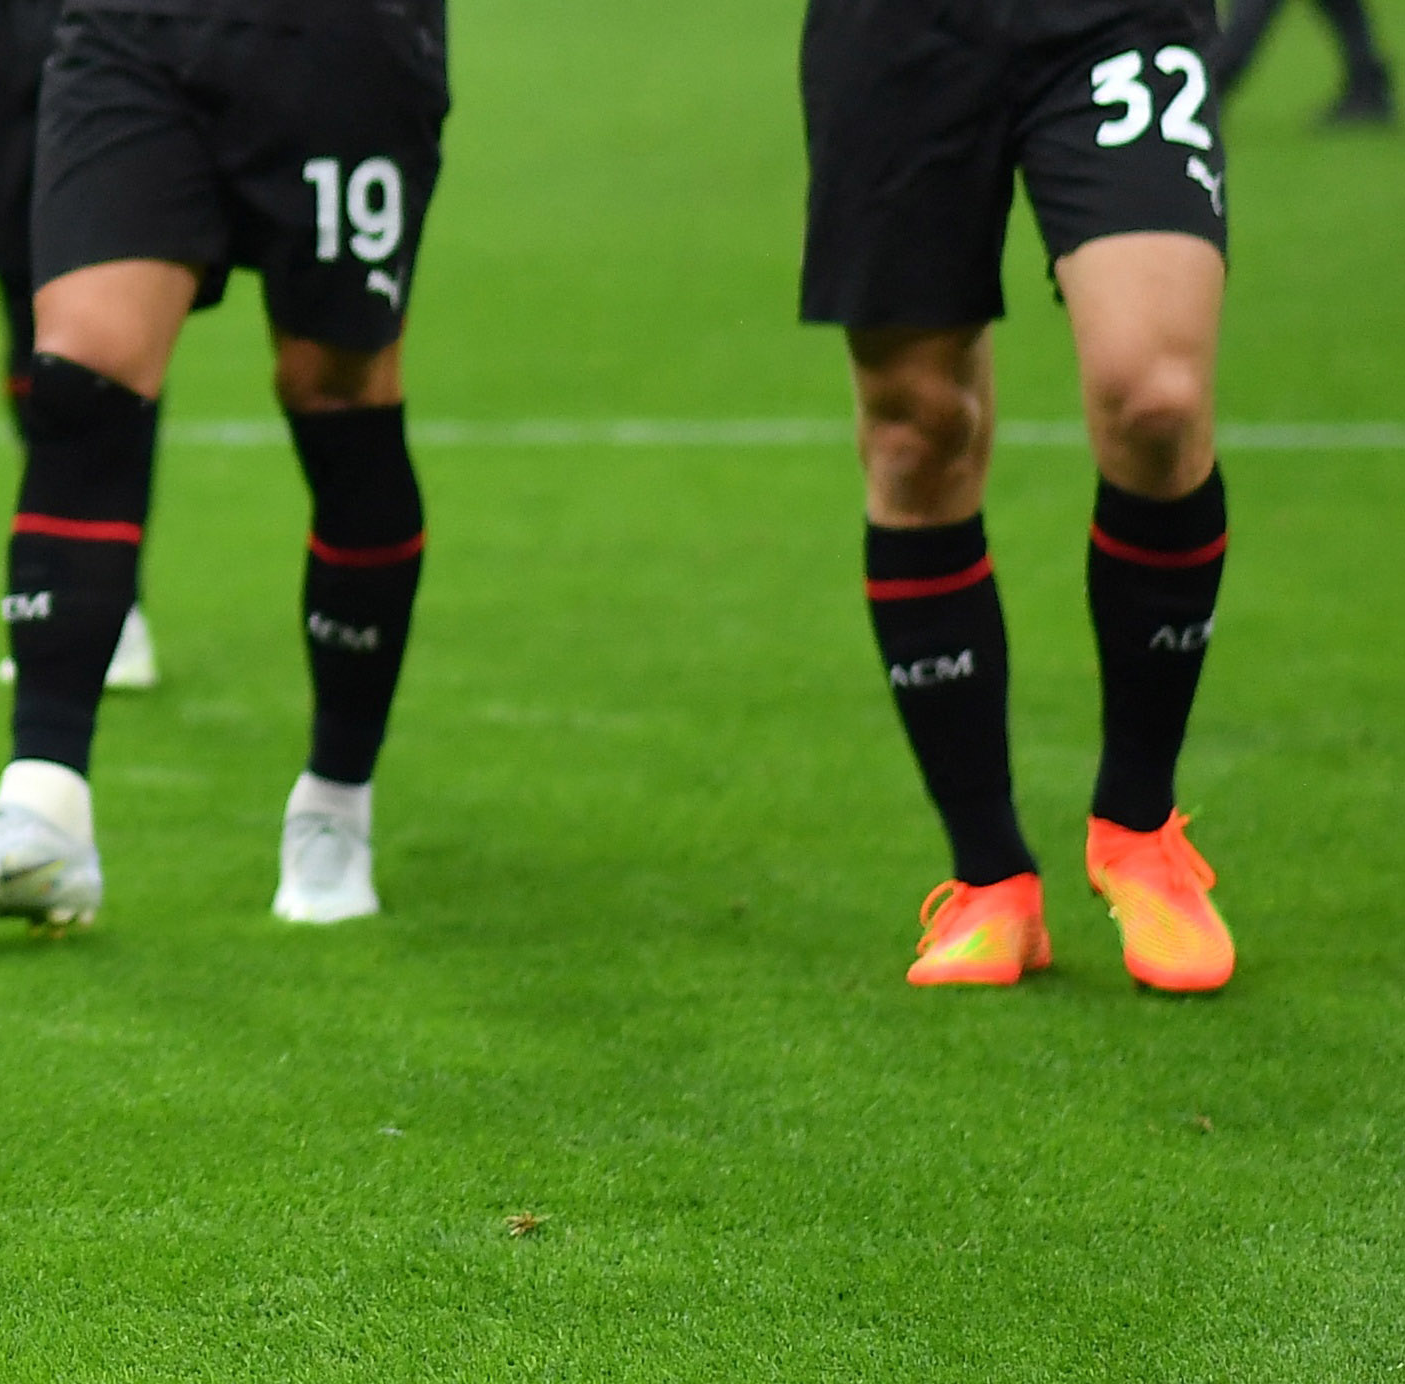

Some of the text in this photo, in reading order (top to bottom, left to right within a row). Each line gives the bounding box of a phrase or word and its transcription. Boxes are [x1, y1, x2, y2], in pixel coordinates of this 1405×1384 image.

[1091, 44, 1213, 151] 32
[302, 155, 404, 263] 19
[1, 590, 53, 622] CM
[890, 648, 974, 687] ACM
